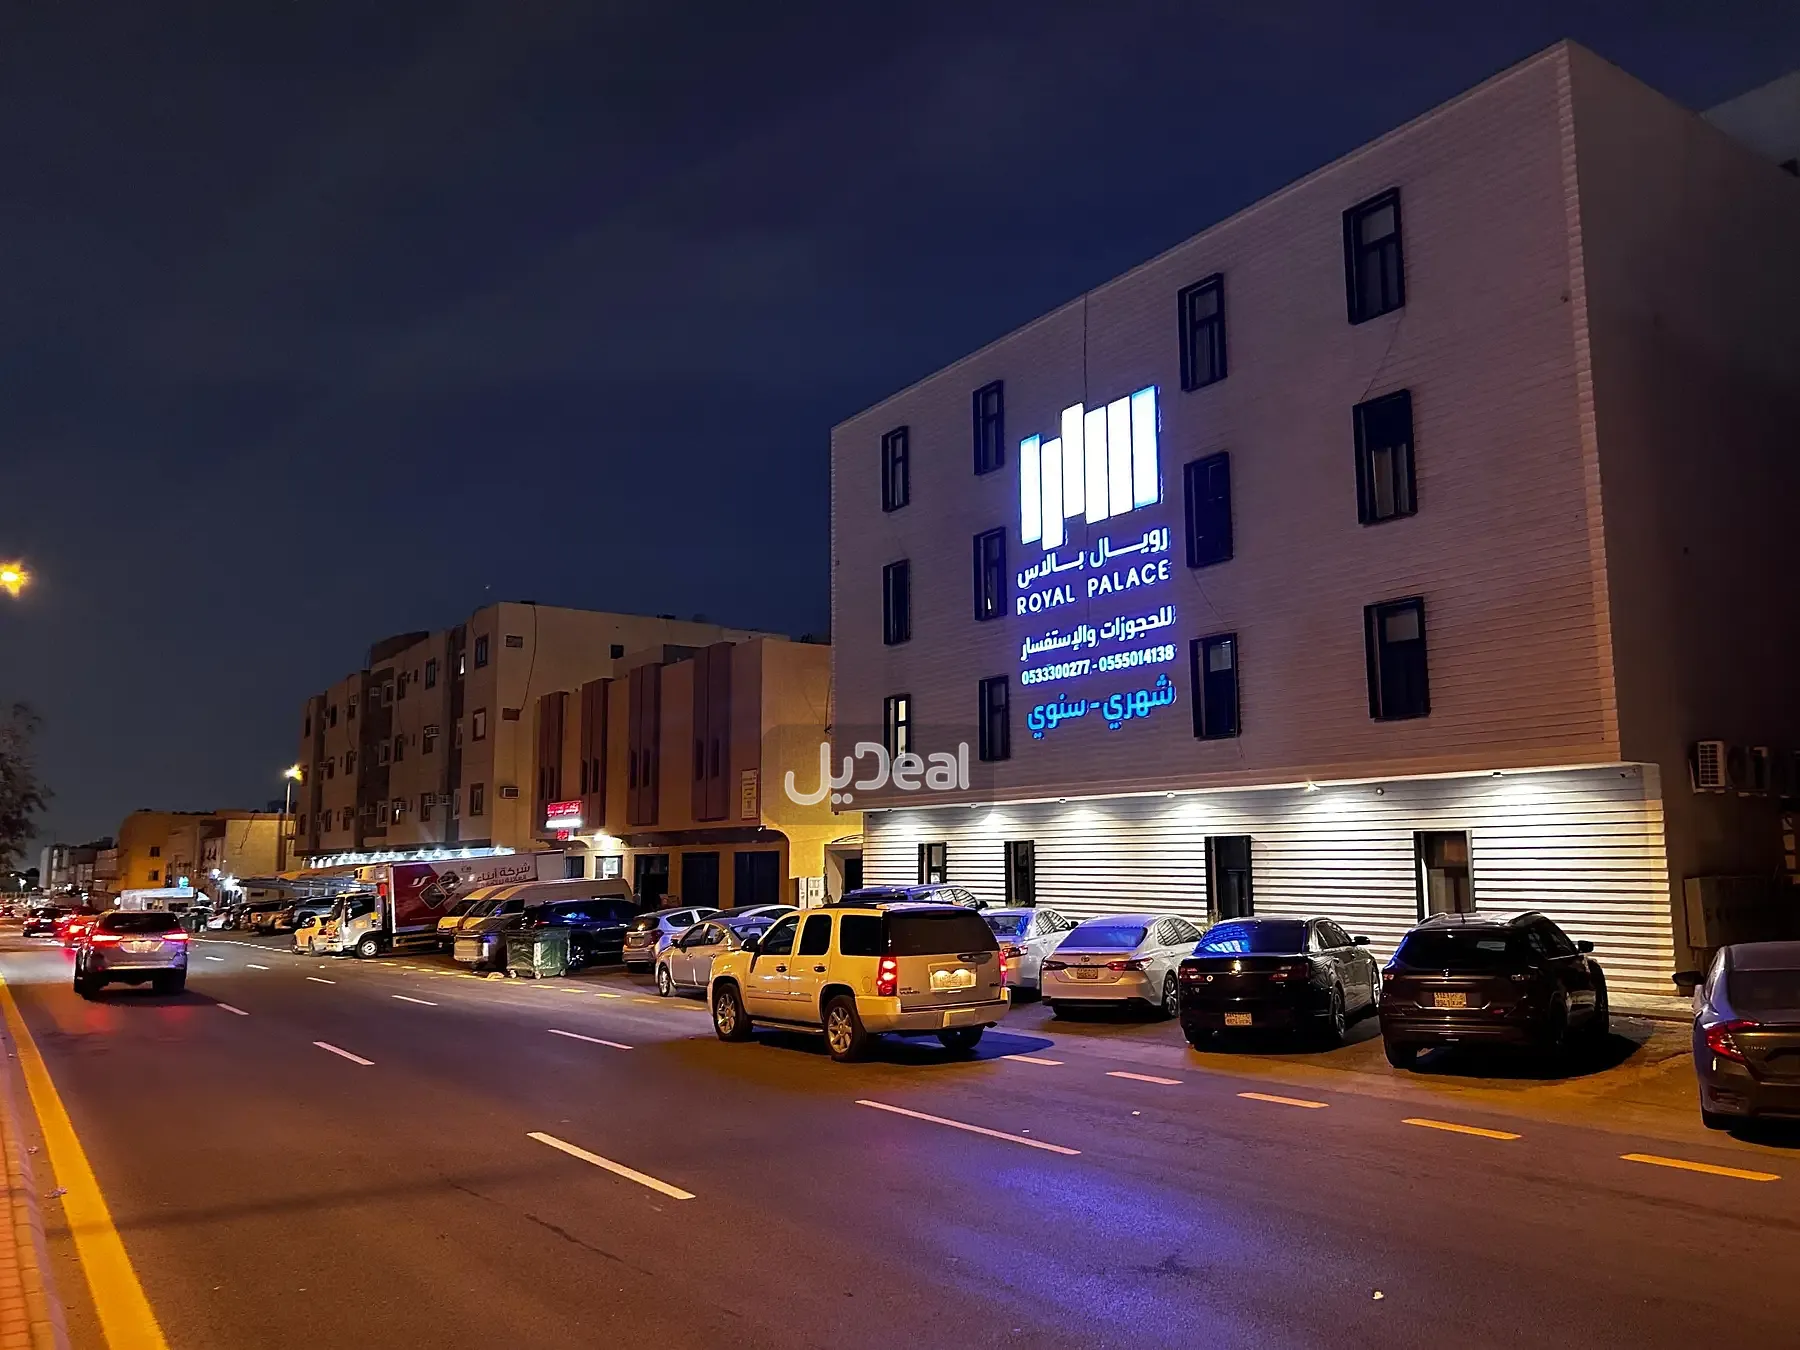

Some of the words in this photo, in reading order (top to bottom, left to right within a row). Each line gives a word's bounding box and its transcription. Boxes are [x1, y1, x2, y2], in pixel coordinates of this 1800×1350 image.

[1089, 527, 1171, 568] رويال
[1016, 584, 1076, 616] ROYAL
[1086, 559, 1171, 598] PALACE
[1017, 551, 1085, 589] بالاس
[1099, 605, 1175, 642] للحجوزات
[1021, 659, 1091, 685] 0533300277
[1098, 644, 1176, 672] 0555014138
[1027, 693, 1086, 739] سنوي
[1102, 674, 1174, 730] شهري
[500, 862, 531, 877] شركة
